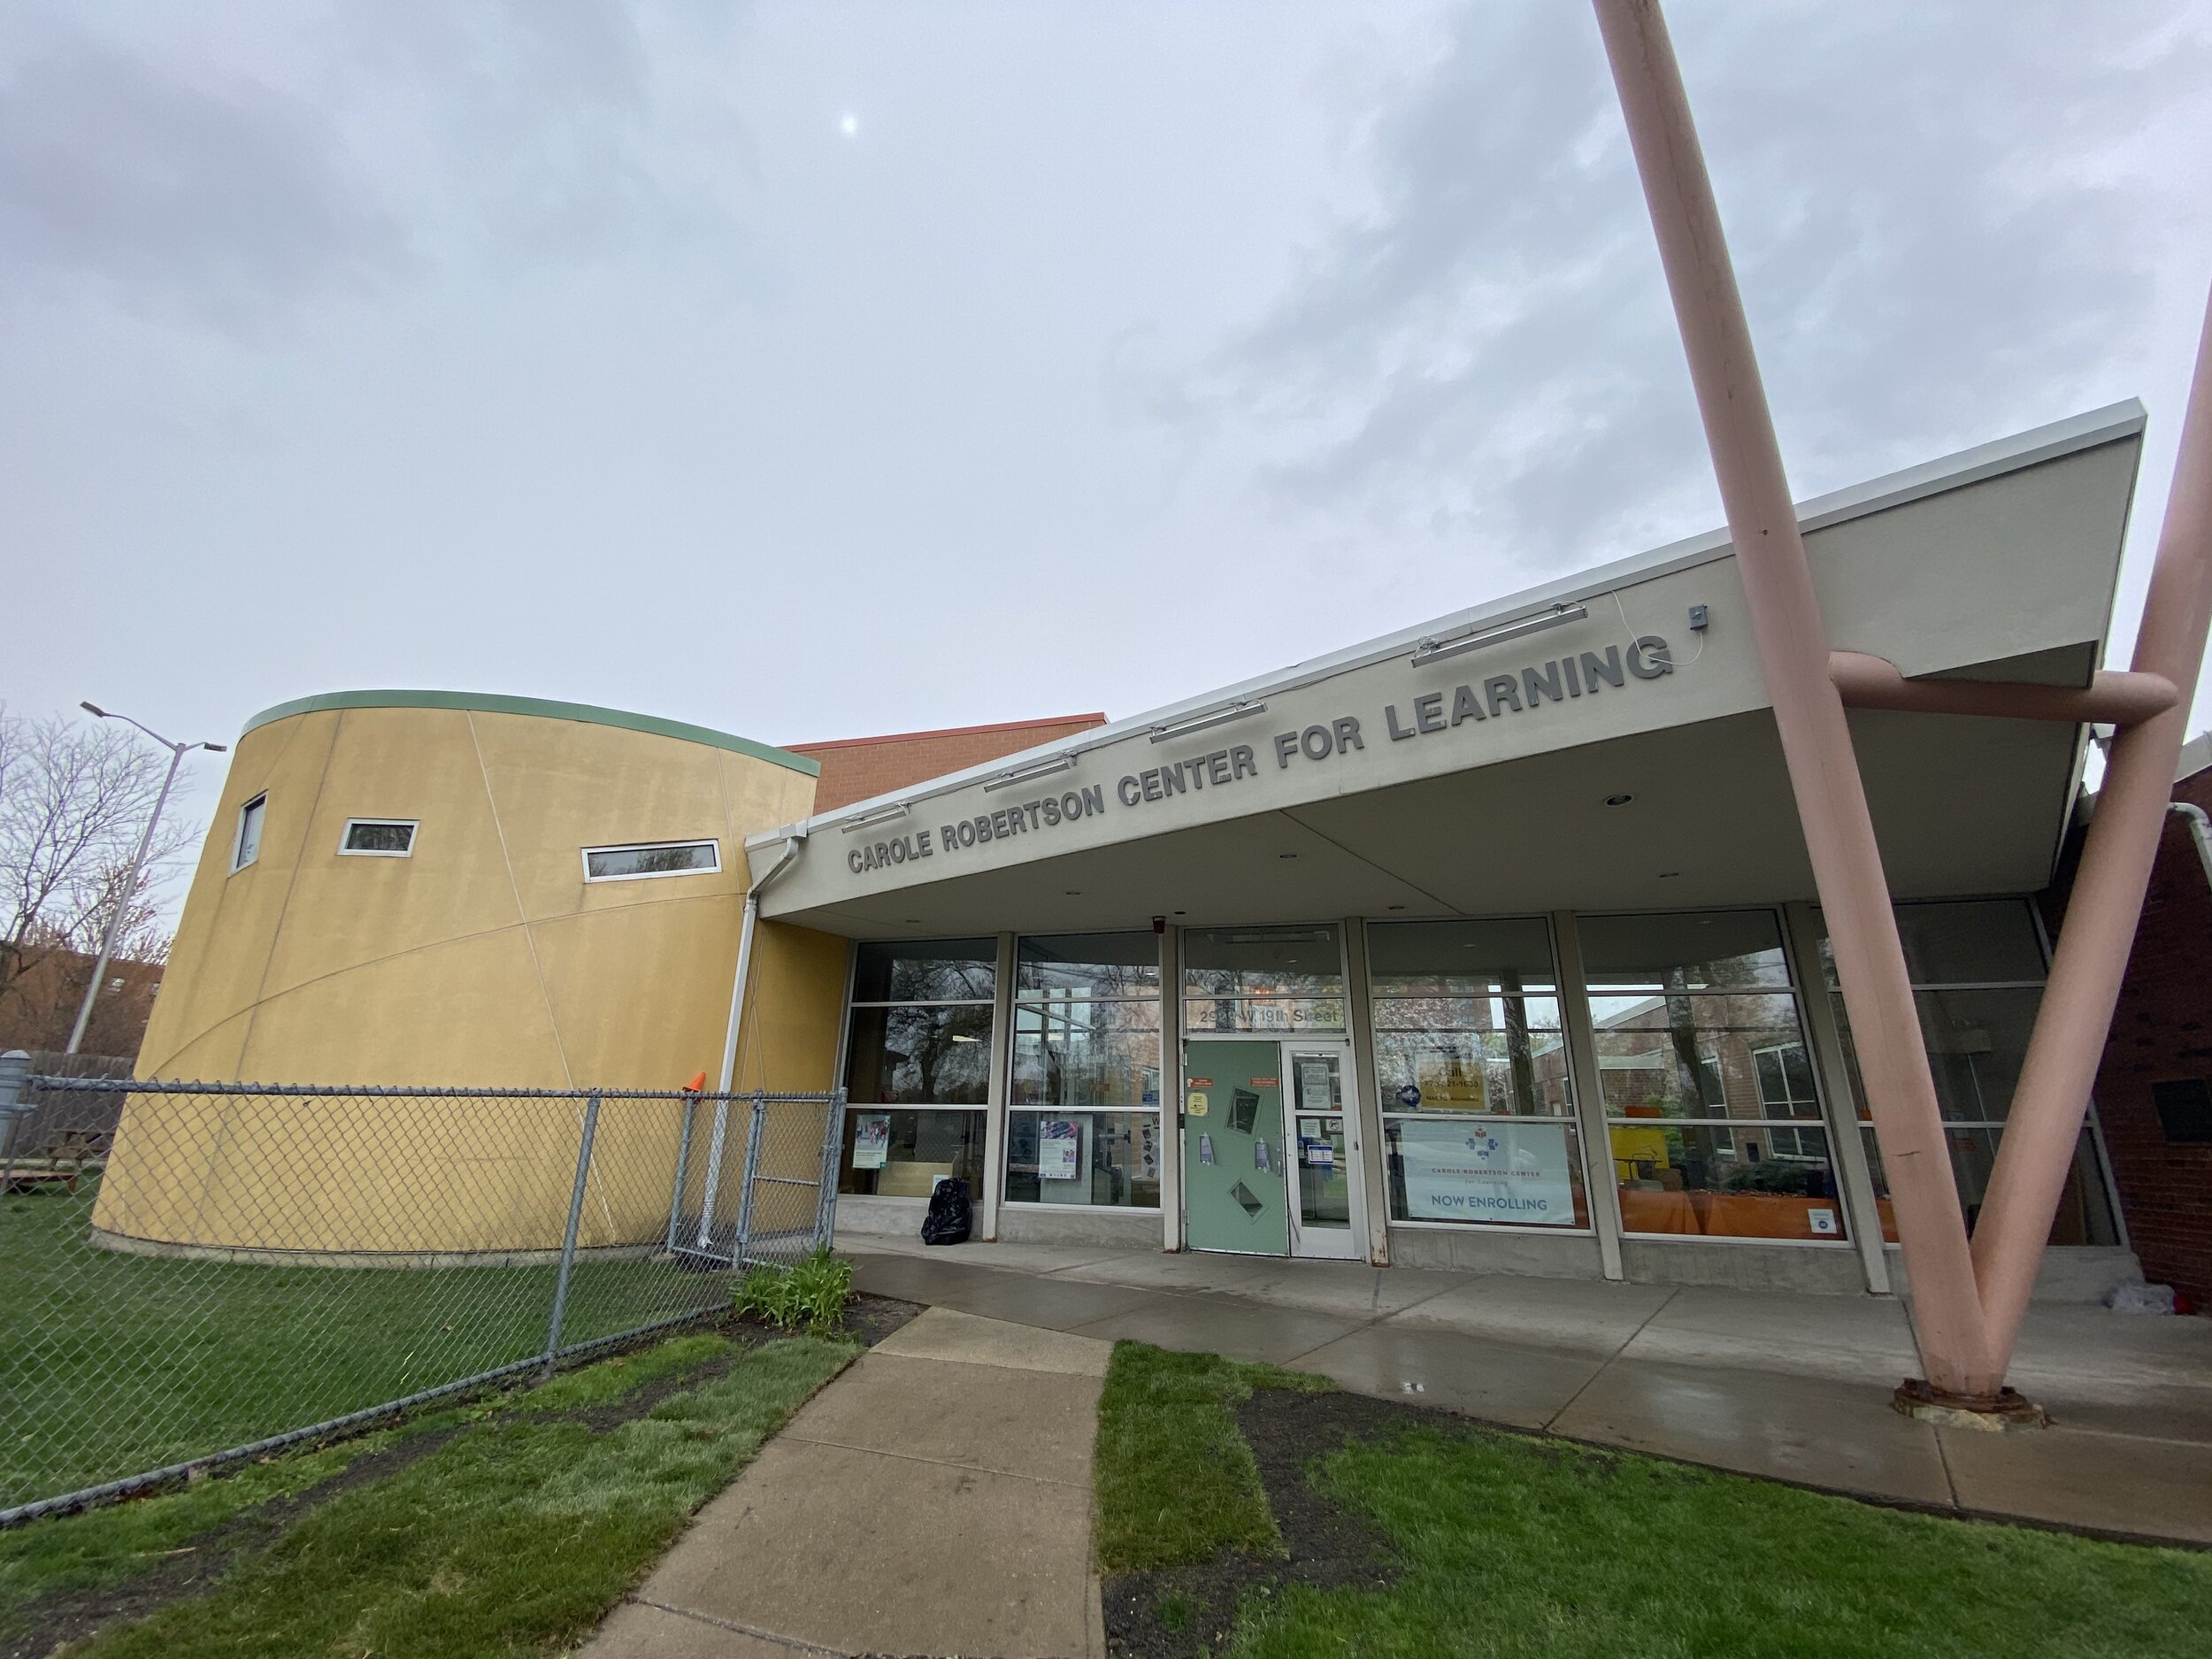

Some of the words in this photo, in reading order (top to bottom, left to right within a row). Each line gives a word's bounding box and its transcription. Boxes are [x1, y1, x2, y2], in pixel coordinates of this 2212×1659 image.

[848, 831, 933, 873] CAROLE
[941, 785, 1104, 851] ROBERTSON
[1117, 744, 1257, 805] CENTER
[1274, 716, 1364, 768] FOR
[1385, 635, 1673, 741] LEARNING
[1261, 1010, 1288, 1022] 19th
[1294, 1009, 1338, 1022] Street
[1439, 1067, 1462, 1077] Call
[1432, 1195, 1464, 1207] NOW
[1468, 1196, 1548, 1211] ENROLLING
